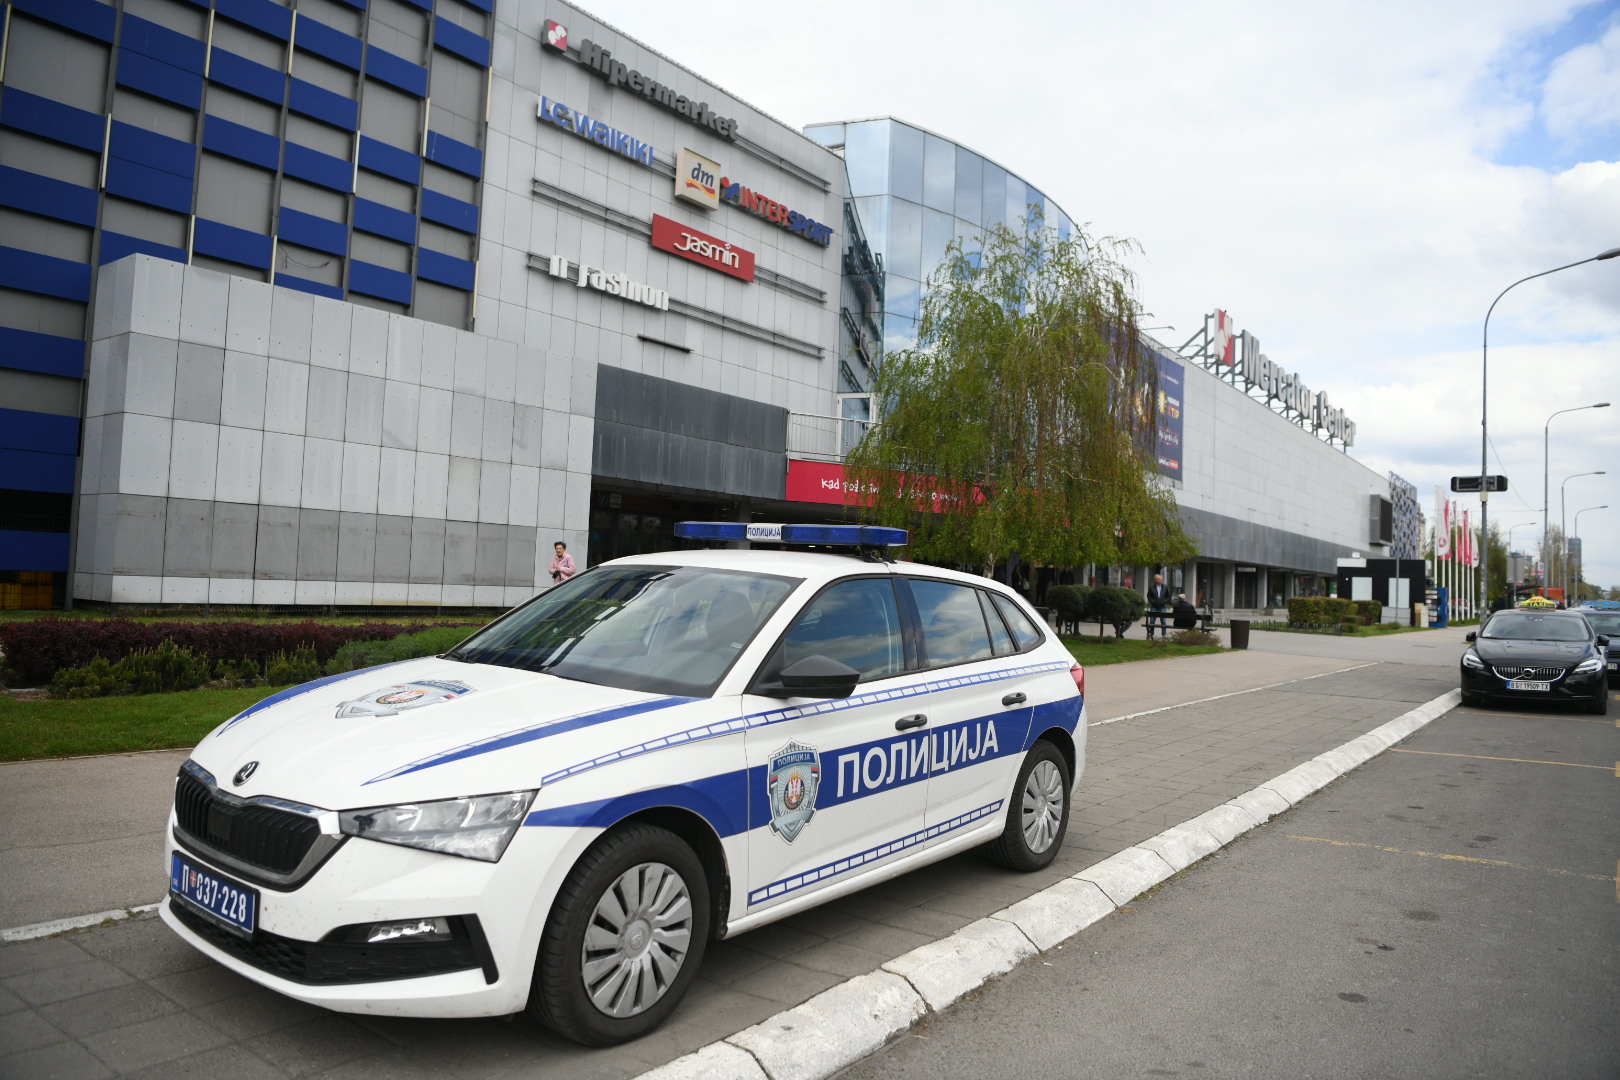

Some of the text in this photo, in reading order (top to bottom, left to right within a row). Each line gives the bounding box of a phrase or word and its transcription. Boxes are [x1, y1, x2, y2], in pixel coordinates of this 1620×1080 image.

[580, 39, 738, 143] Hipermarket
[538, 96, 655, 166] LC Waikiki
[691, 162, 715, 187] dm
[740, 186, 833, 247] INTERSPORT
[674, 232, 739, 269] Jasmin
[1242, 329, 1356, 447] Mercator Centar
[821, 478, 840, 490] kad
[747, 526, 781, 538] ПОЛИЦИЈА
[777, 753, 811, 768] ПОЛИЦИЈА
[837, 720, 999, 797] ПОЛИЦИЈА
